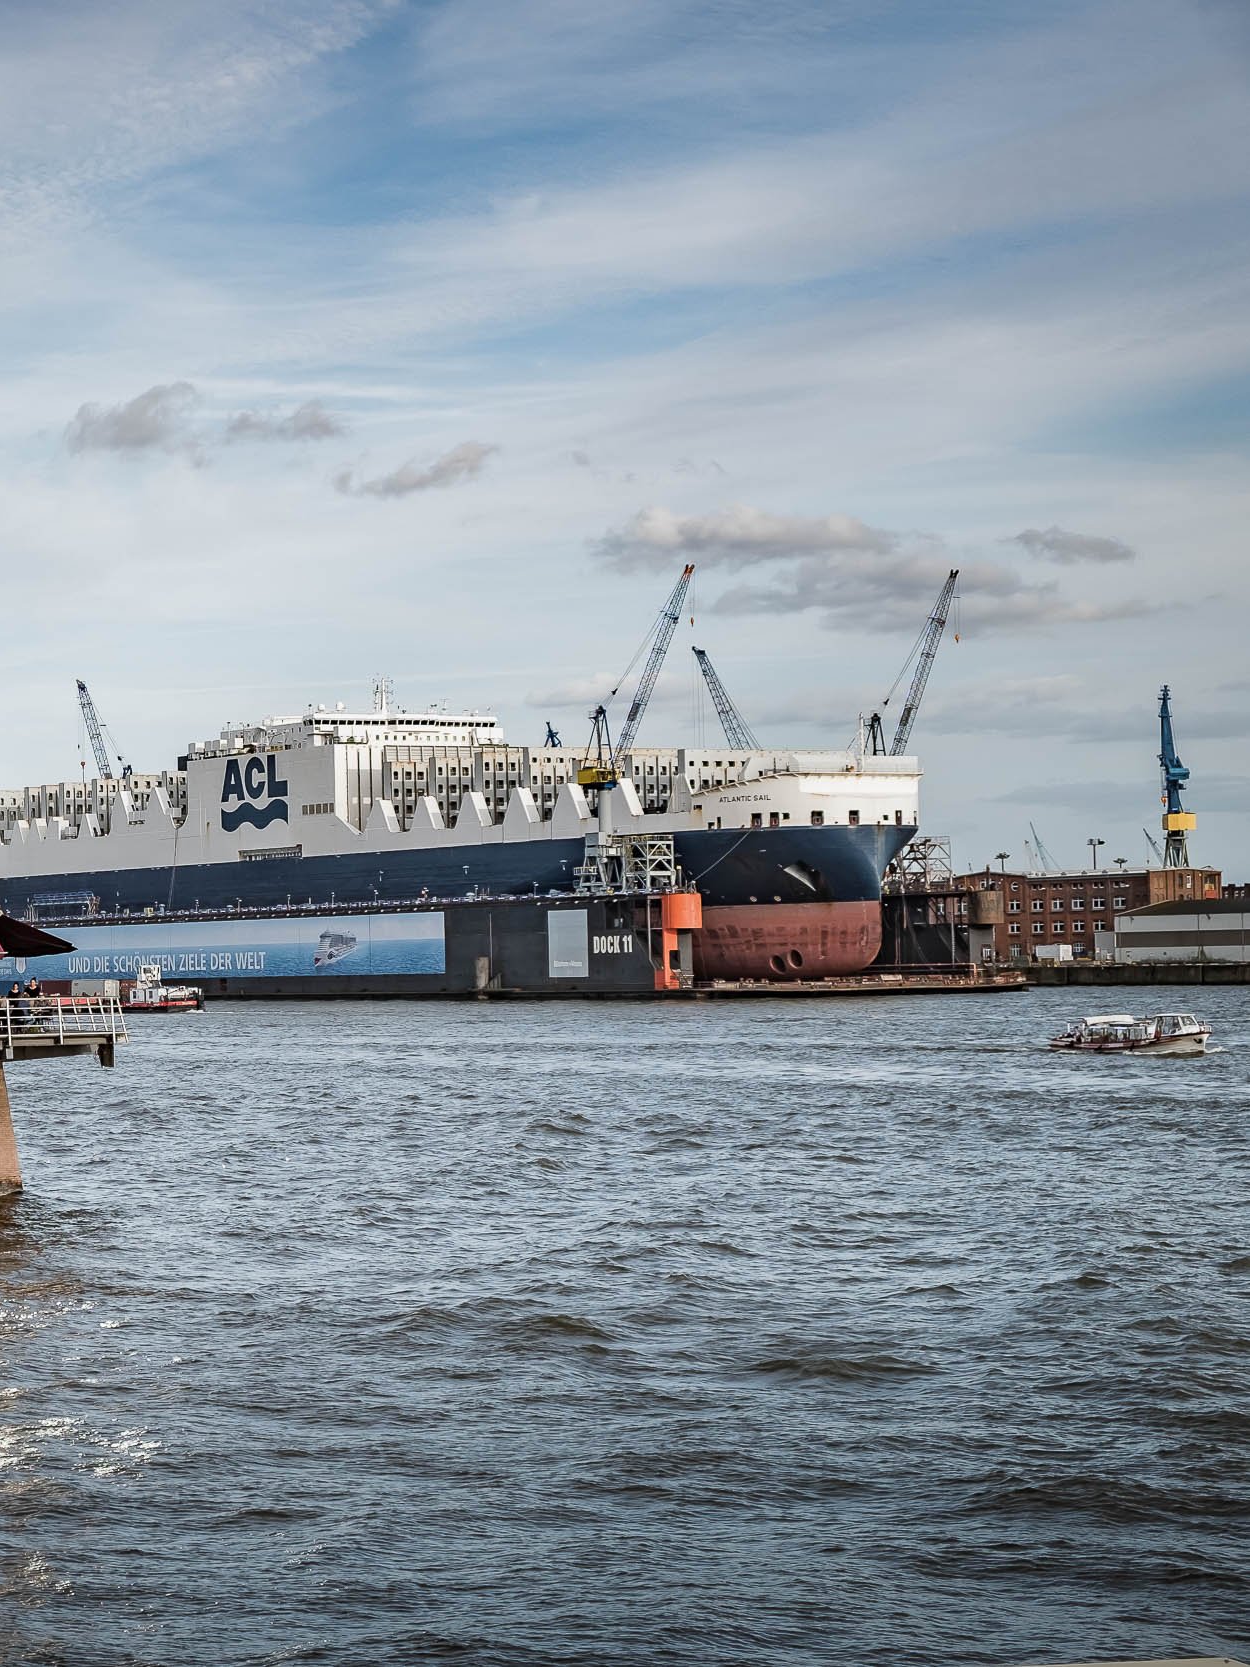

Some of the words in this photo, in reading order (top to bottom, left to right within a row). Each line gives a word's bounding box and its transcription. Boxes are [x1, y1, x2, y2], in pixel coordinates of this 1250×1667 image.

[221, 754, 288, 803] ACL
[719, 795, 751, 803] ATLANTIC
[593, 936, 620, 953] DOCK
[622, 935, 632, 953] 11
[68, 957, 90, 973] UND
[93, 956, 110, 973] DIE
[113, 951, 175, 972] SCHÖNSTEN
[179, 953, 206, 971] ZIELE
[210, 952, 232, 970] DER
[235, 951, 266, 970] WELT
